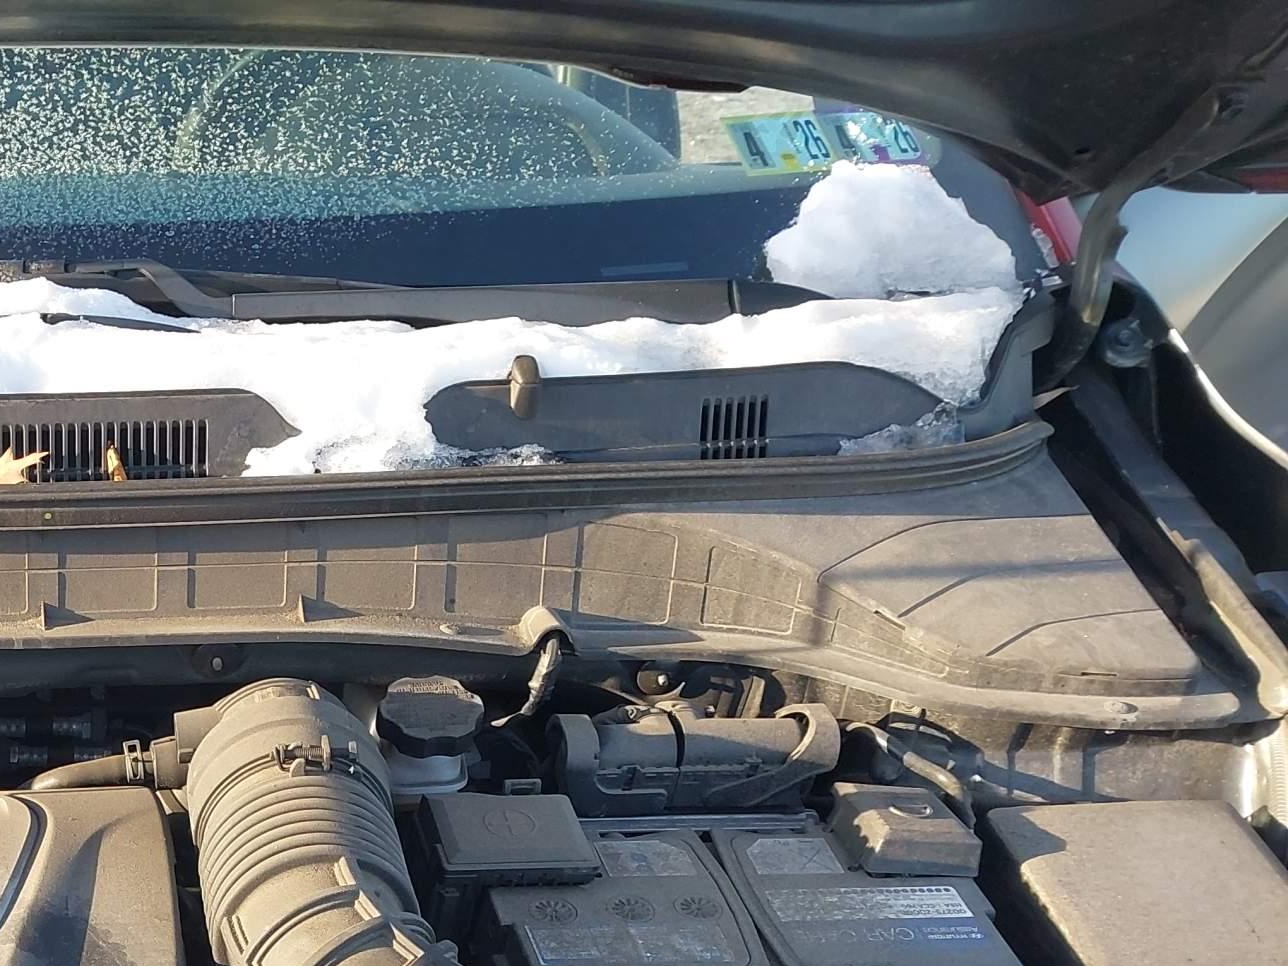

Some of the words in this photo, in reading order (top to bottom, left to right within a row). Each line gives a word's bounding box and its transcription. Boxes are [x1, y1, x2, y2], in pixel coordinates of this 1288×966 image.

[743, 131, 769, 167] 4
[792, 119, 831, 160] 26
[887, 119, 920, 153] 26
